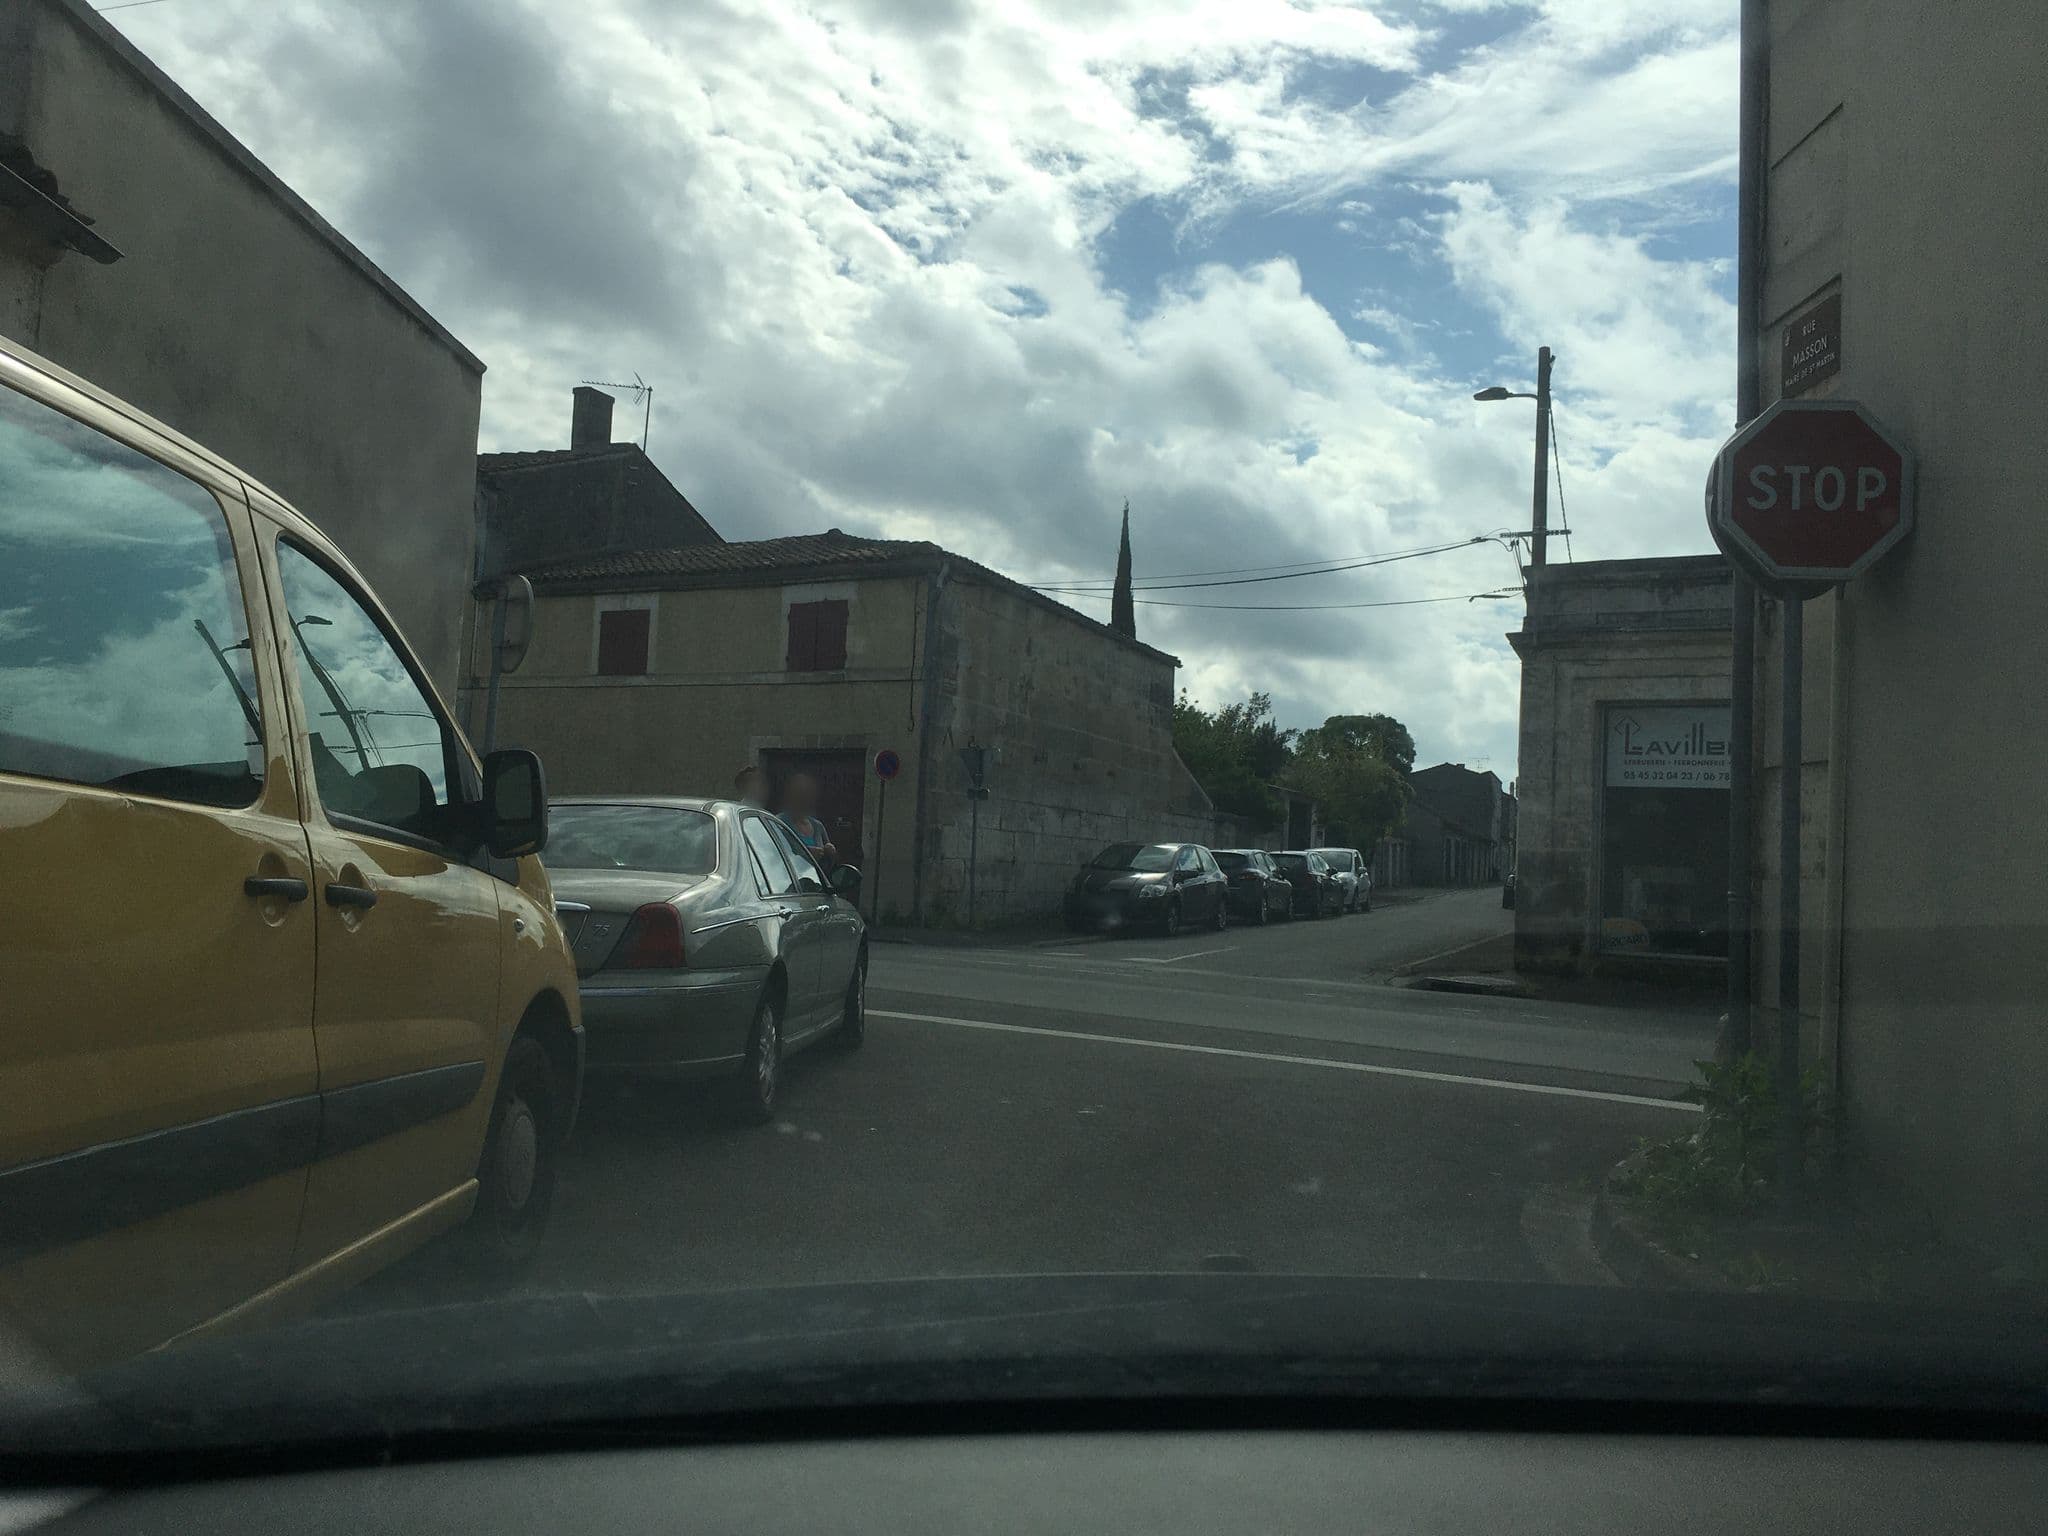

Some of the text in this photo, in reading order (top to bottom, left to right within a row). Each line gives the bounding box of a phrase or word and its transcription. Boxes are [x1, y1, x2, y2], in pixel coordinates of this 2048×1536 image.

[1803, 320, 1816, 336] RUE
[1792, 335, 1828, 368] MASSON
[1747, 465, 1887, 512] STOP
[1624, 770, 1636, 780] 05
[1638, 770, 1650, 780] 45
[1652, 771, 1664, 780] 32
[1681, 771, 1693, 780] 23
[1703, 772, 1715, 781] 06
[1718, 772, 1730, 781] 78
